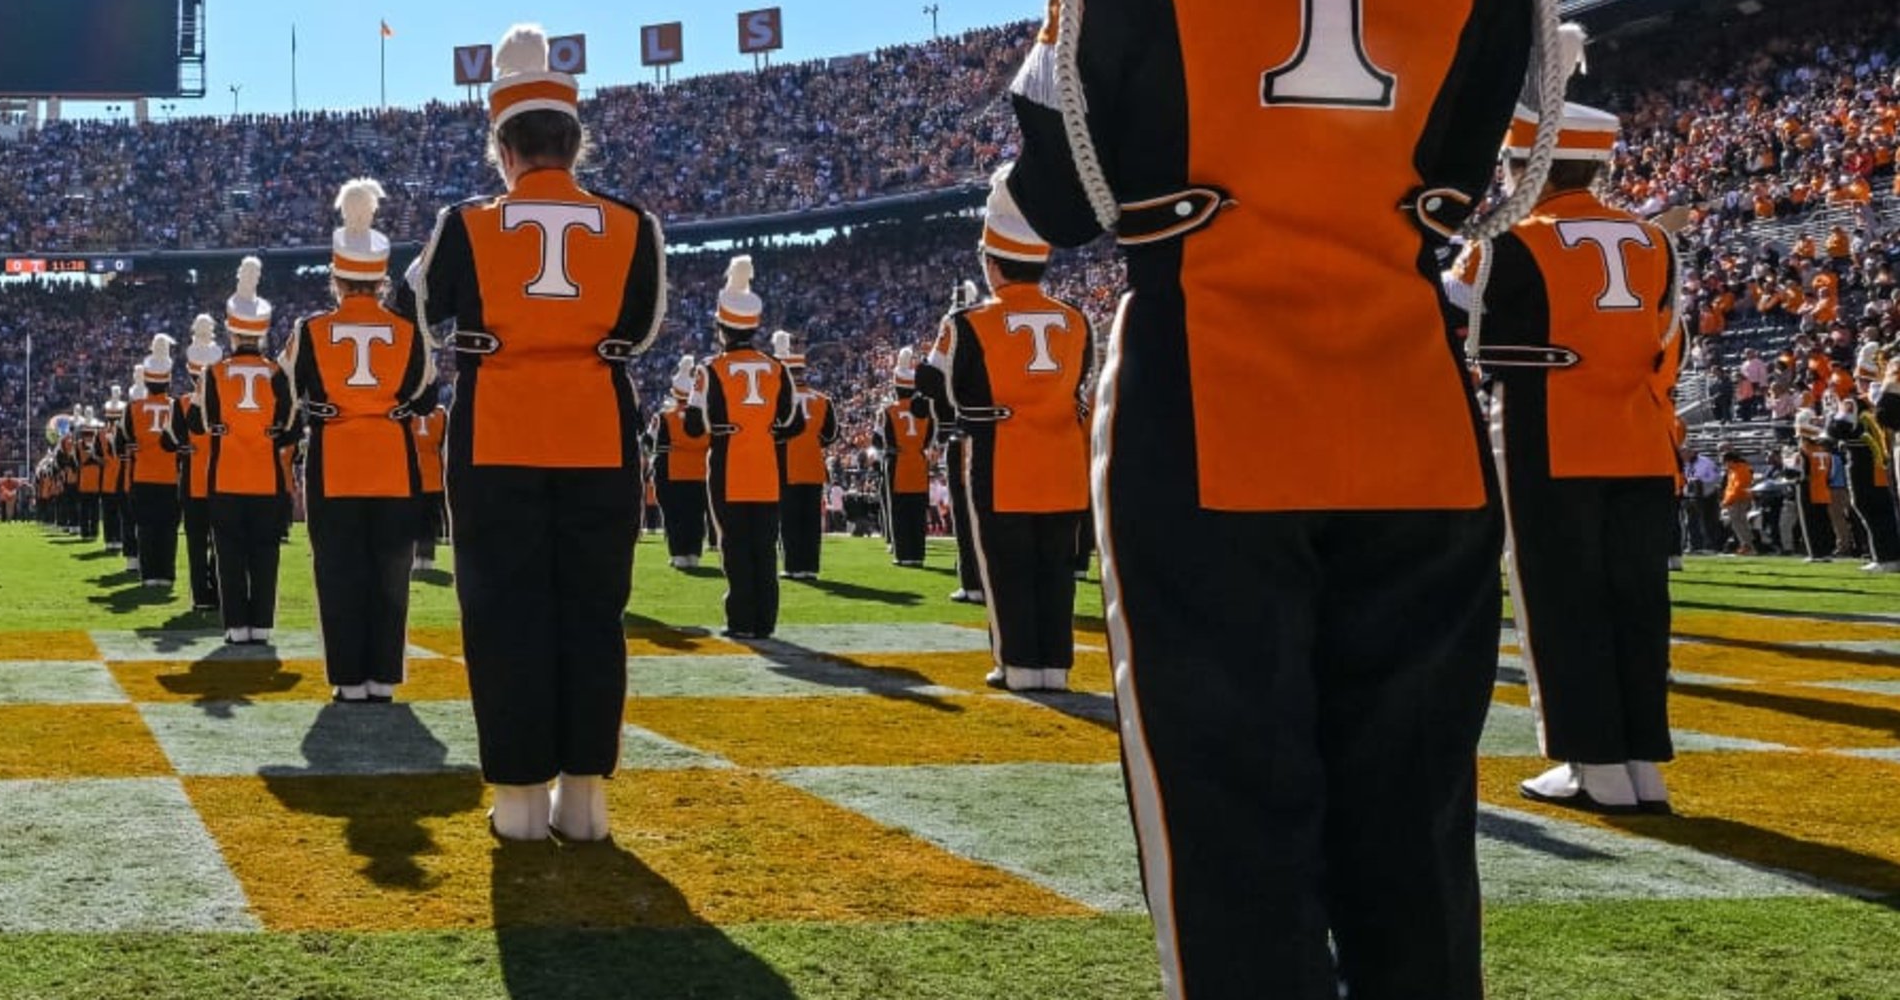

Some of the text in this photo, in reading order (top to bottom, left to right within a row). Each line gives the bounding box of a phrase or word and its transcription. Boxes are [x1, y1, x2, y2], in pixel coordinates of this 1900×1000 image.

[501, 202, 606, 300] T
[1554, 218, 1655, 311] T
[330, 323, 394, 388] T
[1005, 311, 1070, 373] T
[227, 365, 273, 411] T
[728, 361, 773, 405] T
[143, 404, 172, 432] T
